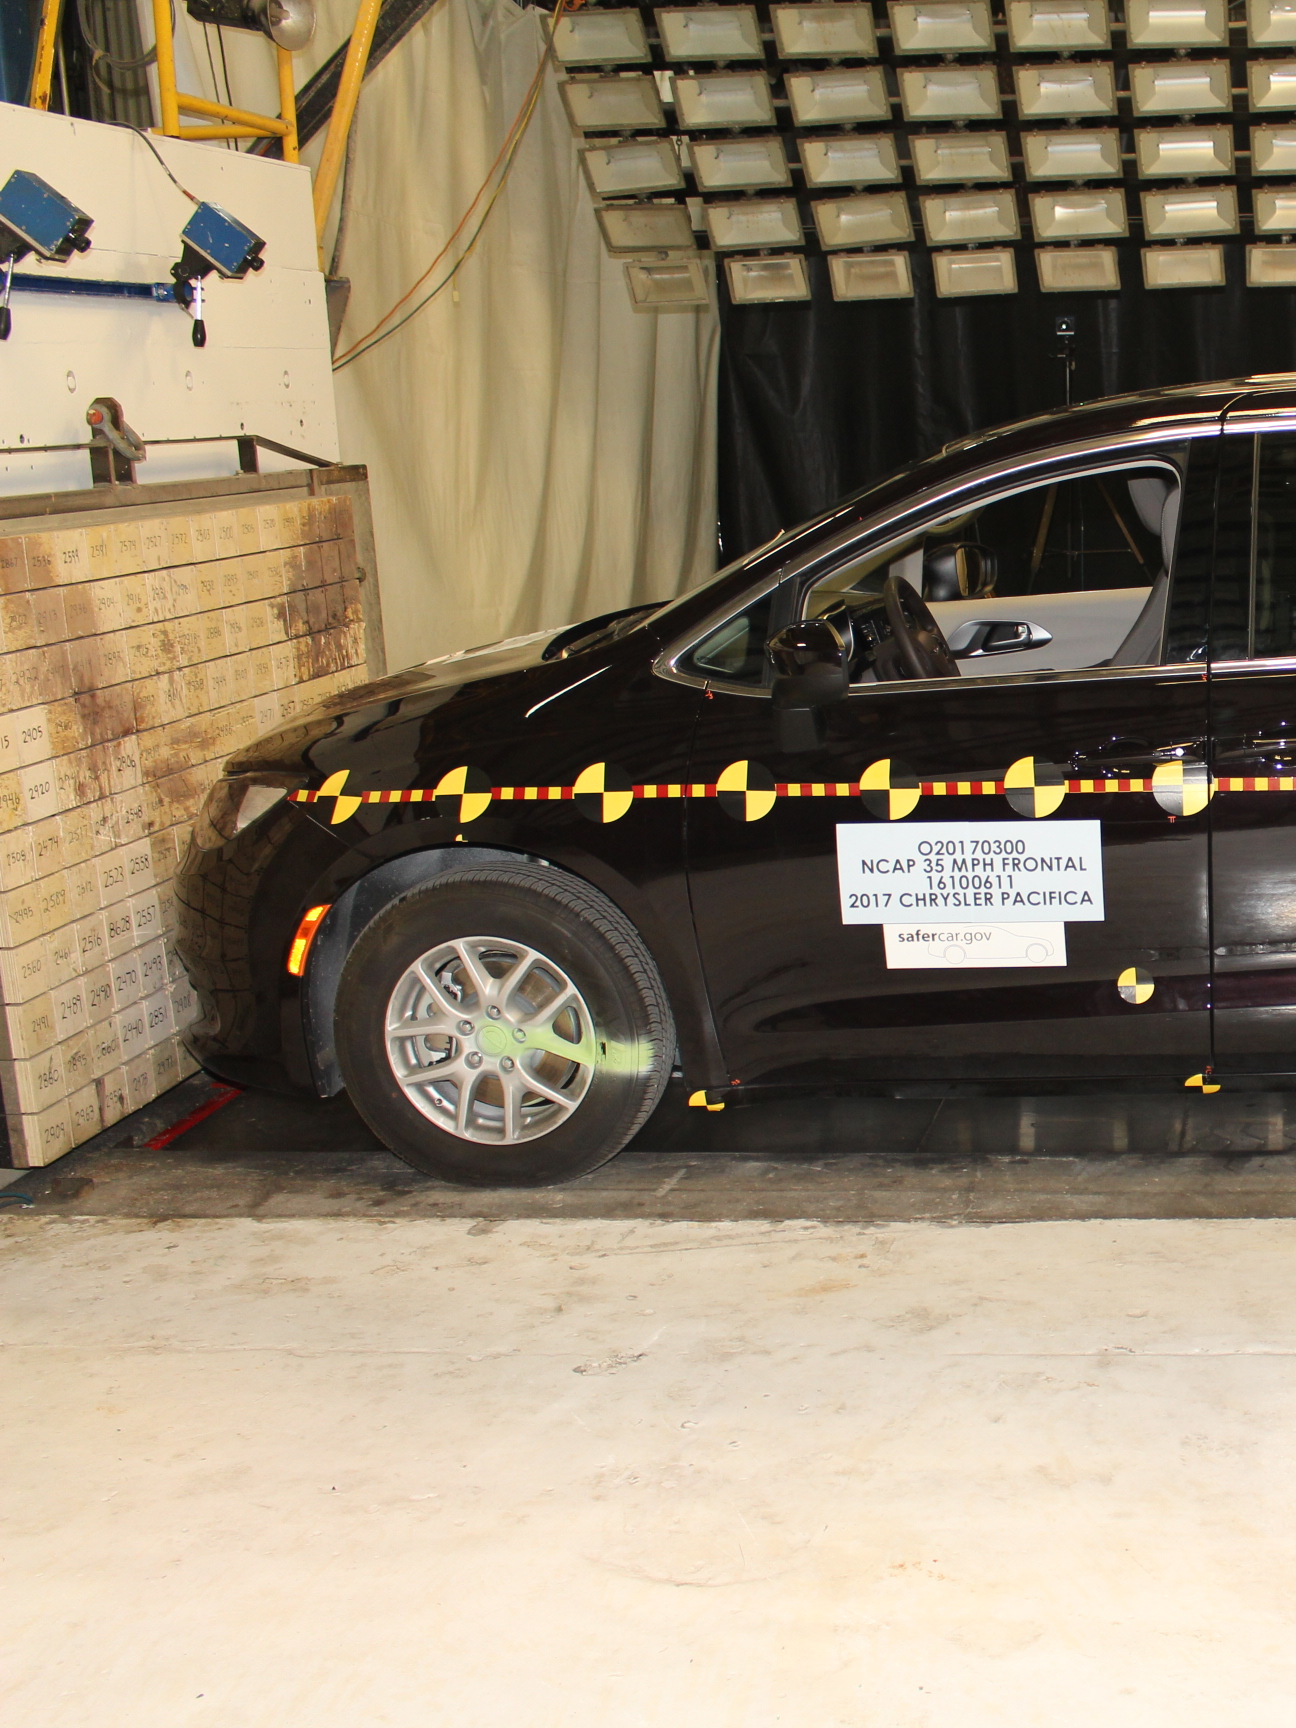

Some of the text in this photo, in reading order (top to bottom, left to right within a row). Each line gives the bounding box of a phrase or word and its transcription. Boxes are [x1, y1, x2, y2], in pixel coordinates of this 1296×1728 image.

[22, 726, 43, 744] 2905
[28, 781, 50, 800] 2920
[130, 854, 149, 875] 2558
[861, 856, 1088, 874] NCAP 35 MPH FRONTAL
[103, 866, 125, 888] 2523
[926, 875, 1014, 890] 16100611
[42, 889, 66, 914] 2589
[848, 890, 1094, 909] 2017 CHRYSLER PACIFICA
[109, 916, 131, 939] 8628
[136, 905, 156, 928] 2557
[897, 929, 993, 944] safercar.gov
[22, 959, 42, 979] 2560
[143, 955, 163, 977] 2493
[116, 970, 137, 992] 2470
[90, 983, 111, 1007] 2490
[61, 995, 83, 1020] 2489
[149, 1006, 168, 1029] 2851
[32, 1015, 50, 1033] 2491
[123, 1018, 144, 1043] 2940
[75, 1104, 95, 1126] 2963
[44, 1122, 66, 1144] 2909
